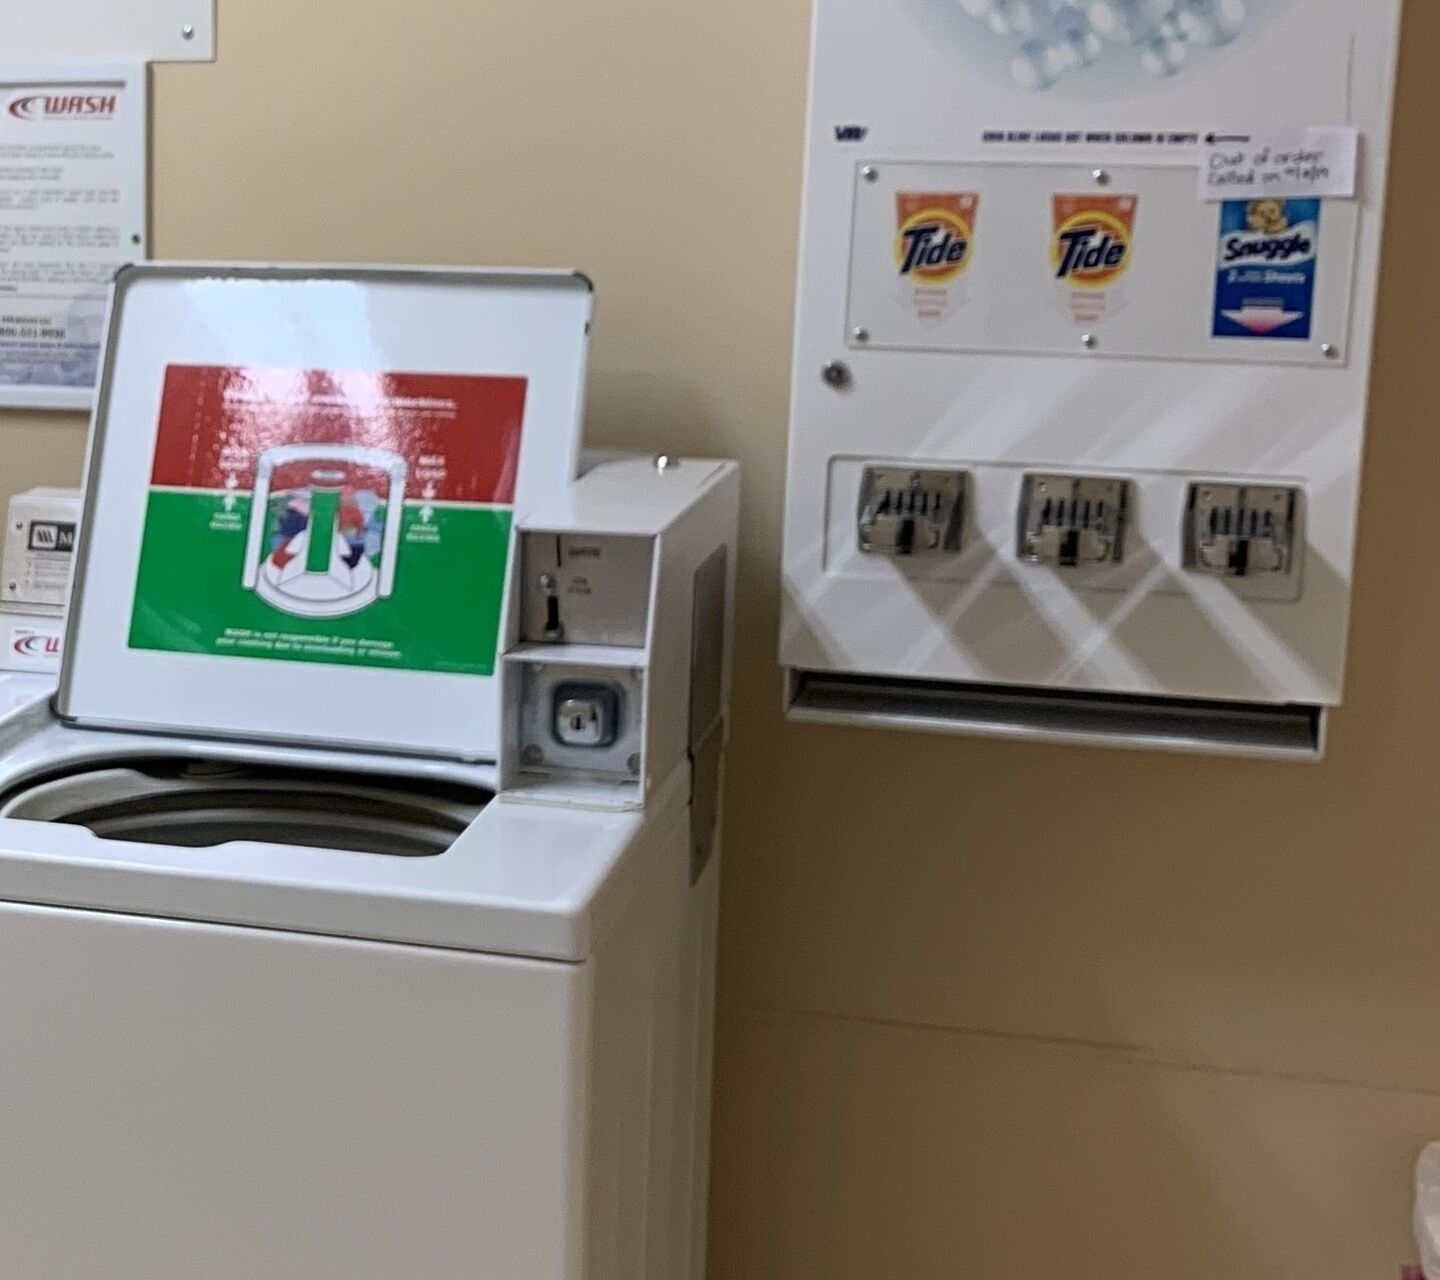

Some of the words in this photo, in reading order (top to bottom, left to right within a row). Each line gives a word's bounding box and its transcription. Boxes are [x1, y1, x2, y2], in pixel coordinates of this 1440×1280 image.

[44, 95, 117, 115] WASH
[899, 225, 968, 276] Tide
[1055, 228, 1126, 281] Tide
[1223, 232, 1312, 262] Snuggle
